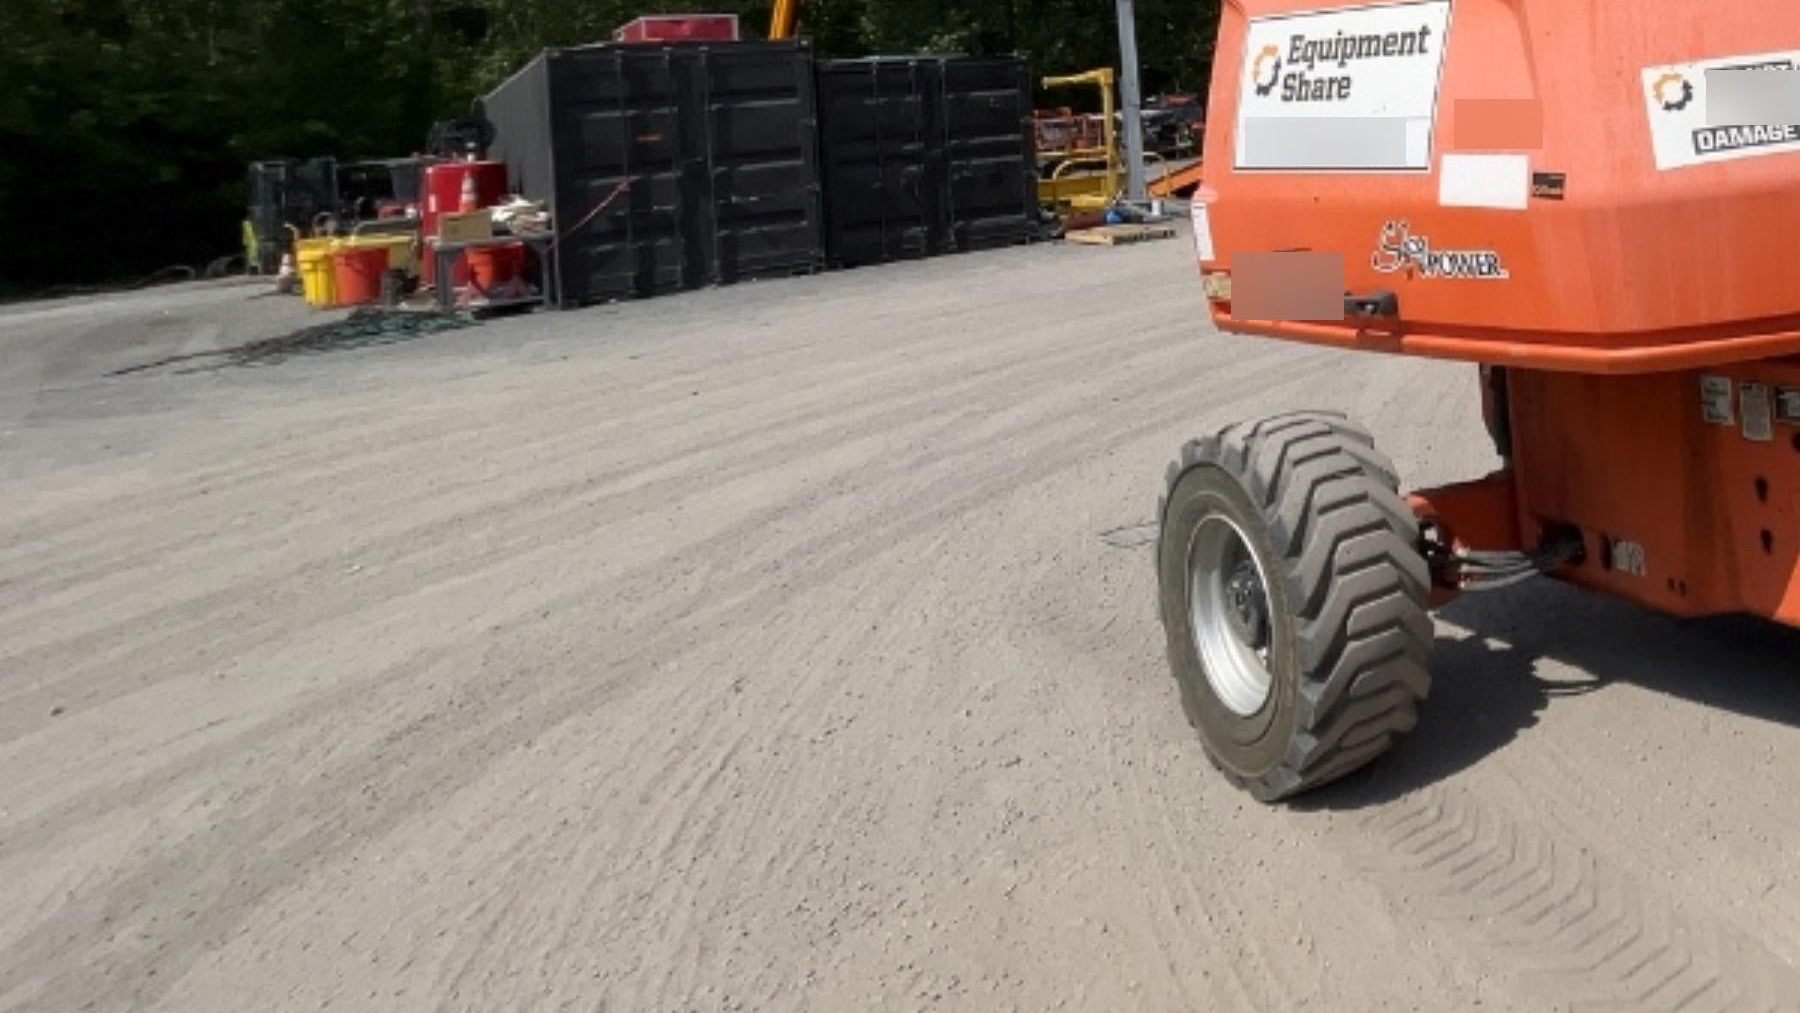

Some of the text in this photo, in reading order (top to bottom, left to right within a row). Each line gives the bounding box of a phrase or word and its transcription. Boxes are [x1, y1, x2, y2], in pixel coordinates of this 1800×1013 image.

[1286, 25, 1431, 68] Equipment
[1280, 71, 1353, 103] Share
[1696, 124, 1799, 151] DAMAGE
